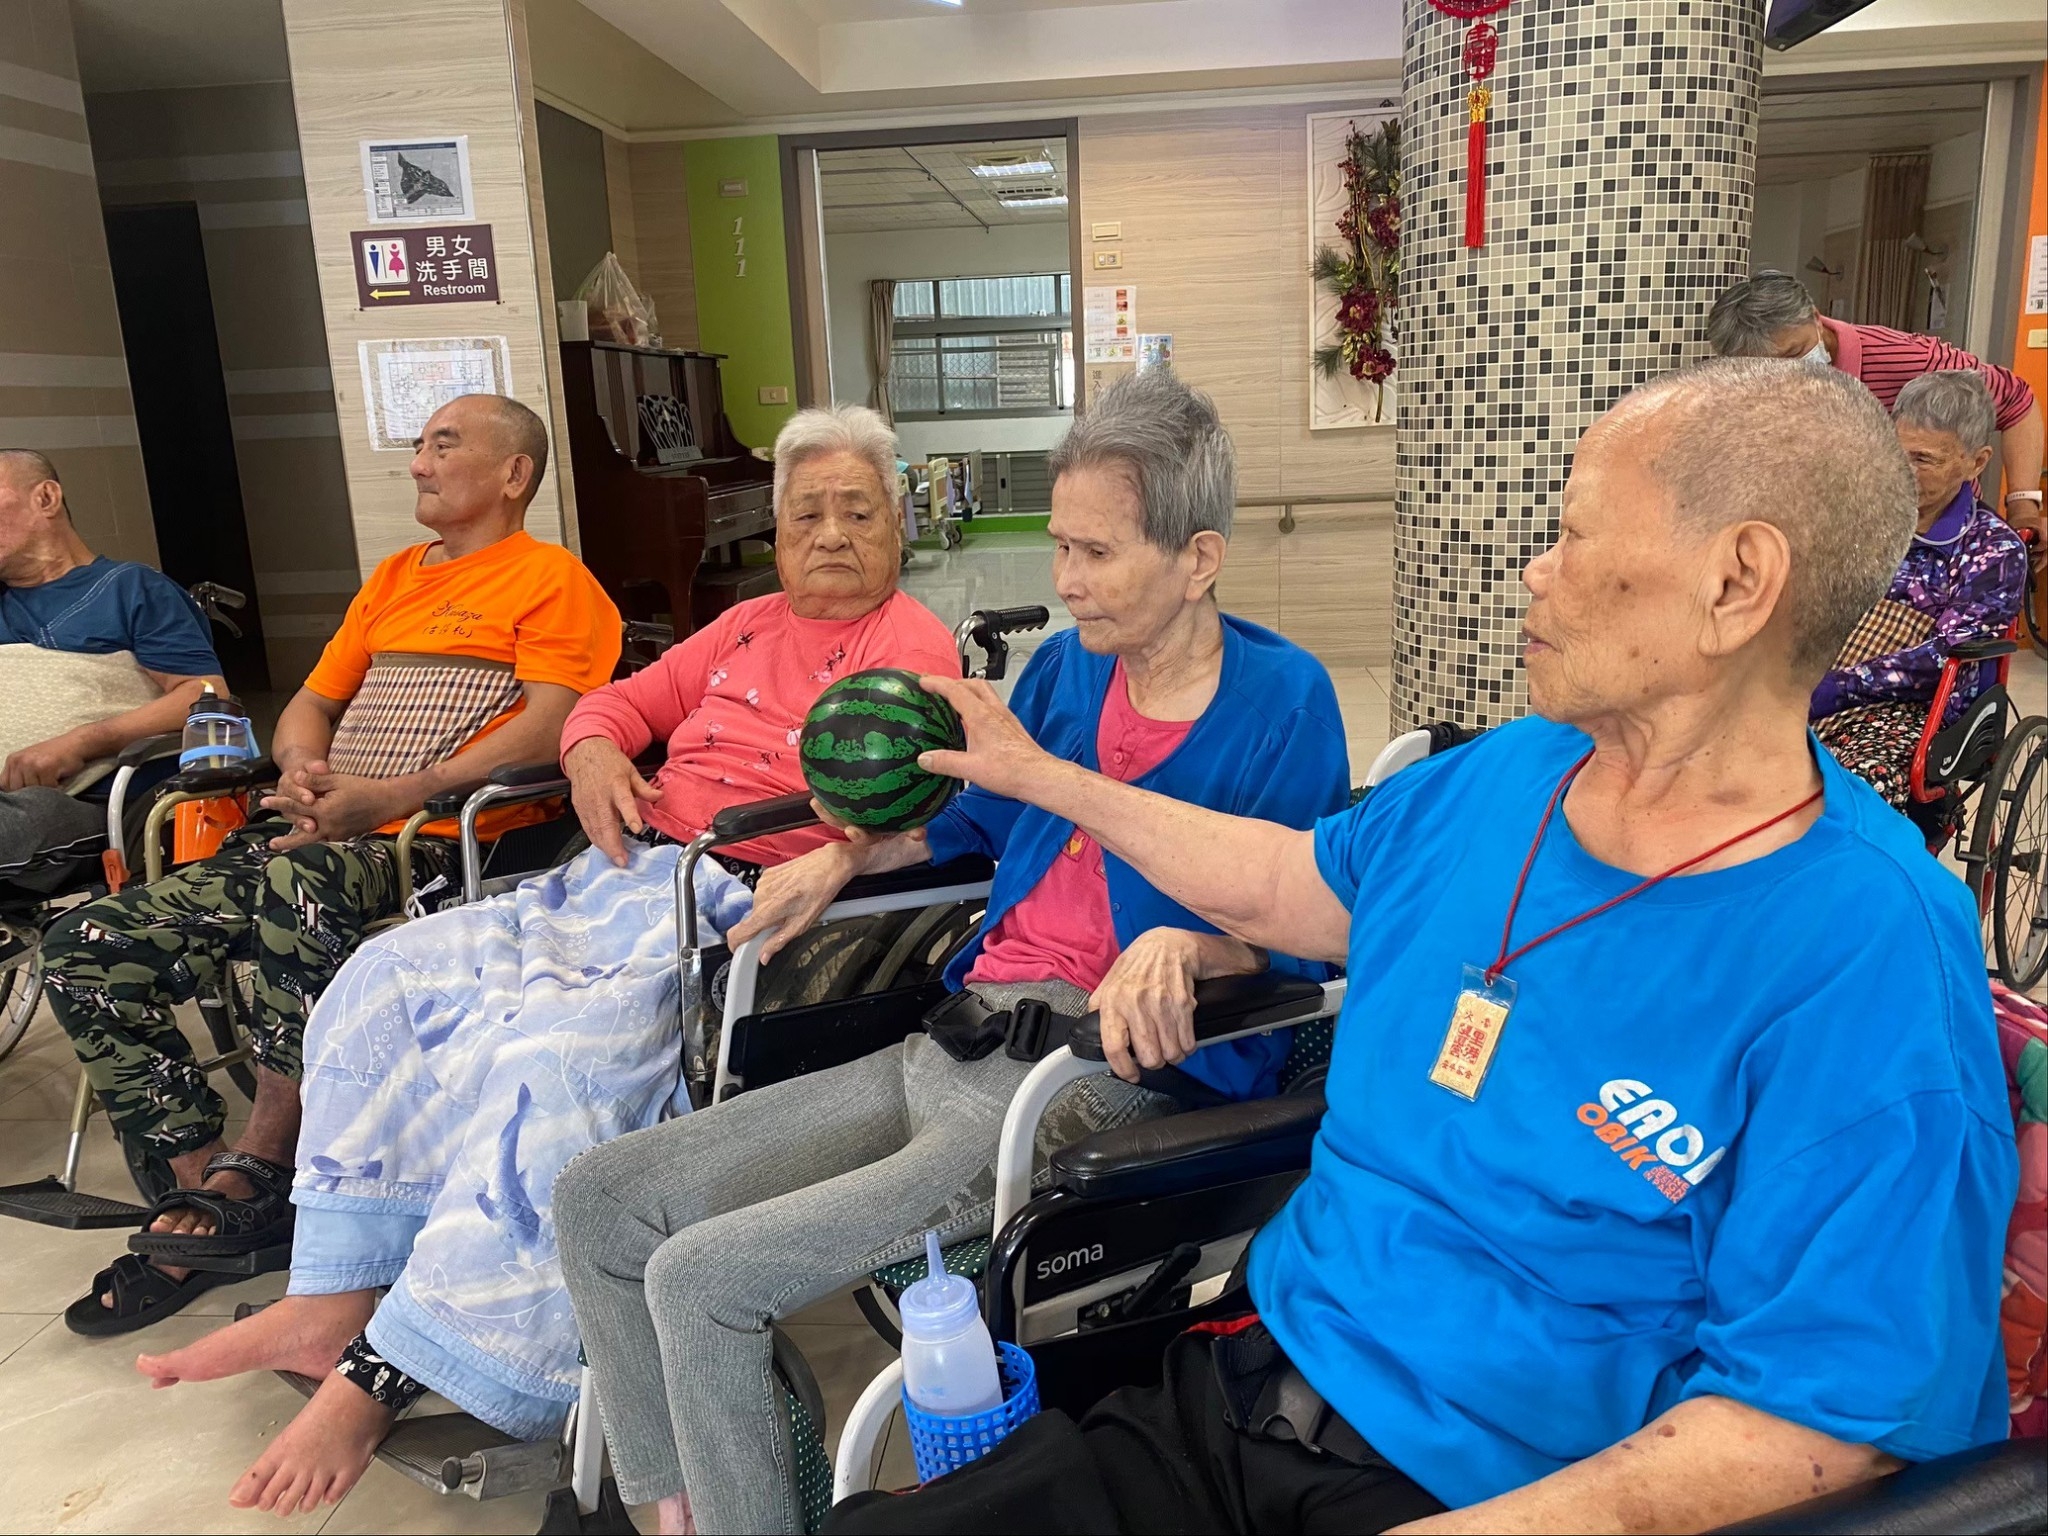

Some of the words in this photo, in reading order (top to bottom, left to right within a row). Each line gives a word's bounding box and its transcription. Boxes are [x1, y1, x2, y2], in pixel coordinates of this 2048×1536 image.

[426, 234, 474, 258] 男女
[732, 216, 747, 277] 111
[415, 258, 489, 282] 洗手間
[423, 282, 486, 297] Restroom
[1577, 1102, 1659, 1171] OBIK
[1037, 1243, 1104, 1280] soma
